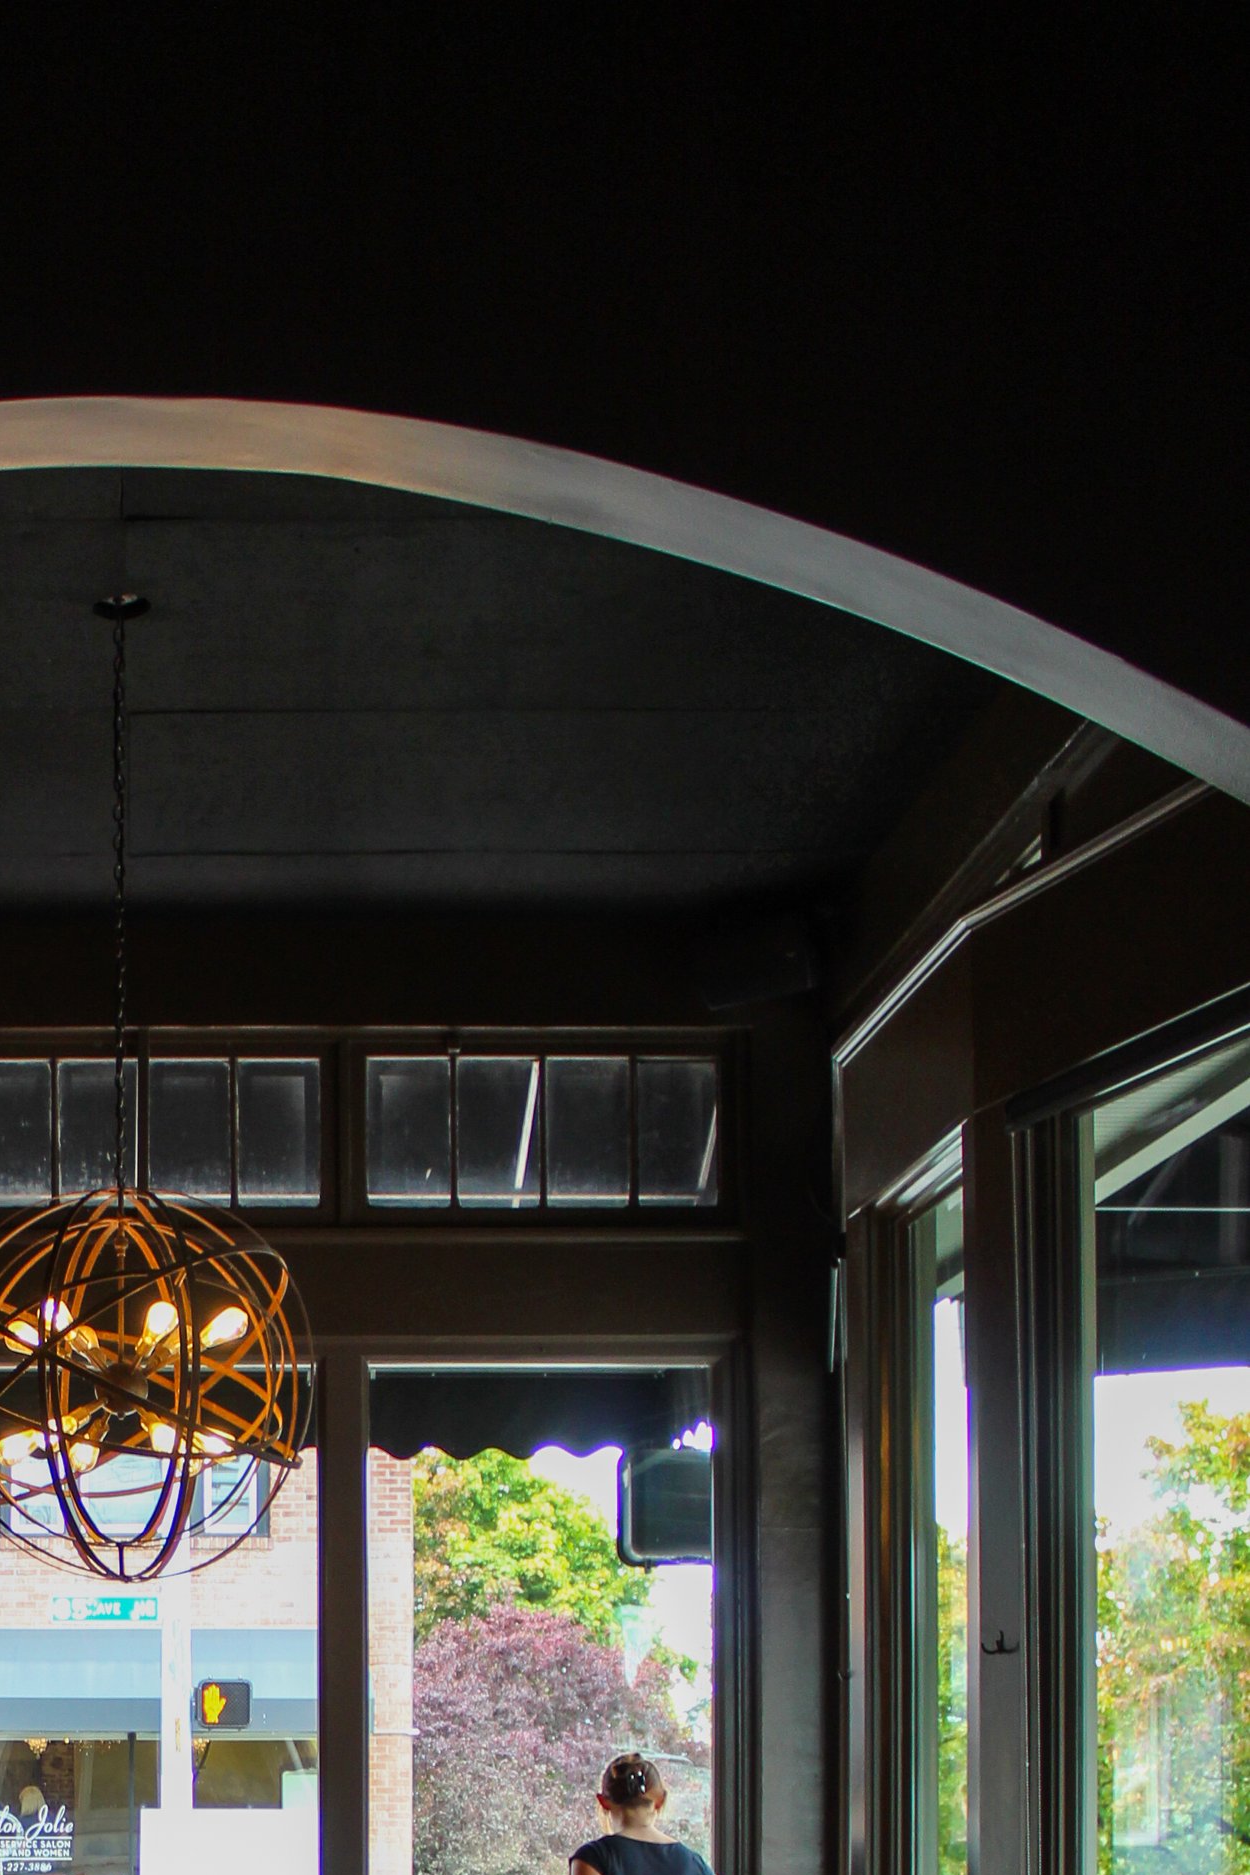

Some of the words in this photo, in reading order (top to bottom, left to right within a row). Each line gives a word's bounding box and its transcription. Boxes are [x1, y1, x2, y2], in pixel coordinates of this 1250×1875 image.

[96, 1602, 121, 1616] AVE
[25, 1804, 74, 1841] Jolie
[0, 1840, 38, 1848] SERVICE
[40, 1840, 71, 1848] SALON
[12, 1849, 31, 1857] AND
[33, 1849, 70, 1857] WOMEN
